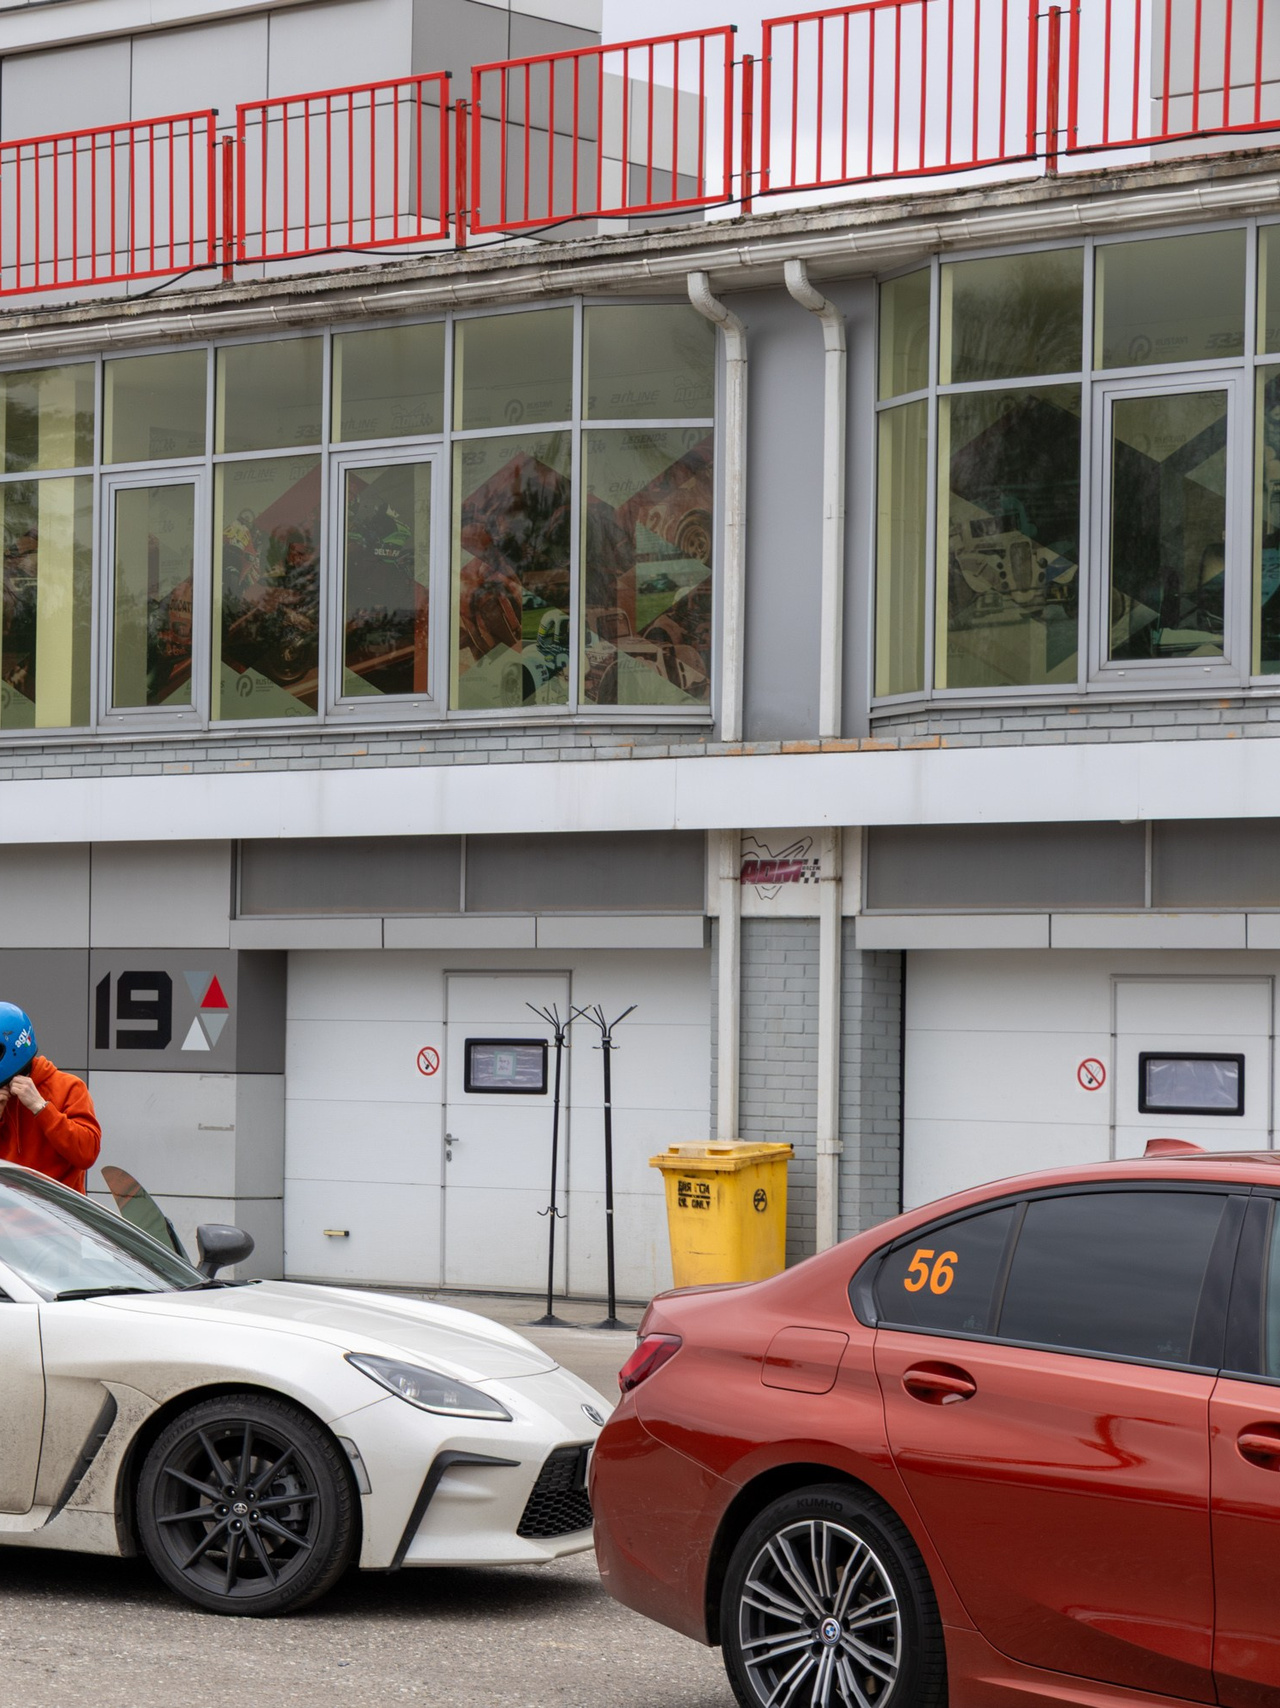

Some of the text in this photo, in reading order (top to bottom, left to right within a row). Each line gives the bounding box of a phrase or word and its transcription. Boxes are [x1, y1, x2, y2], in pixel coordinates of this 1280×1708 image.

[95, 971, 172, 1049] 19
[15, 1028, 28, 1048] agv
[904, 1249, 958, 1294] 56
[796, 1498, 844, 1512] KUMHO
